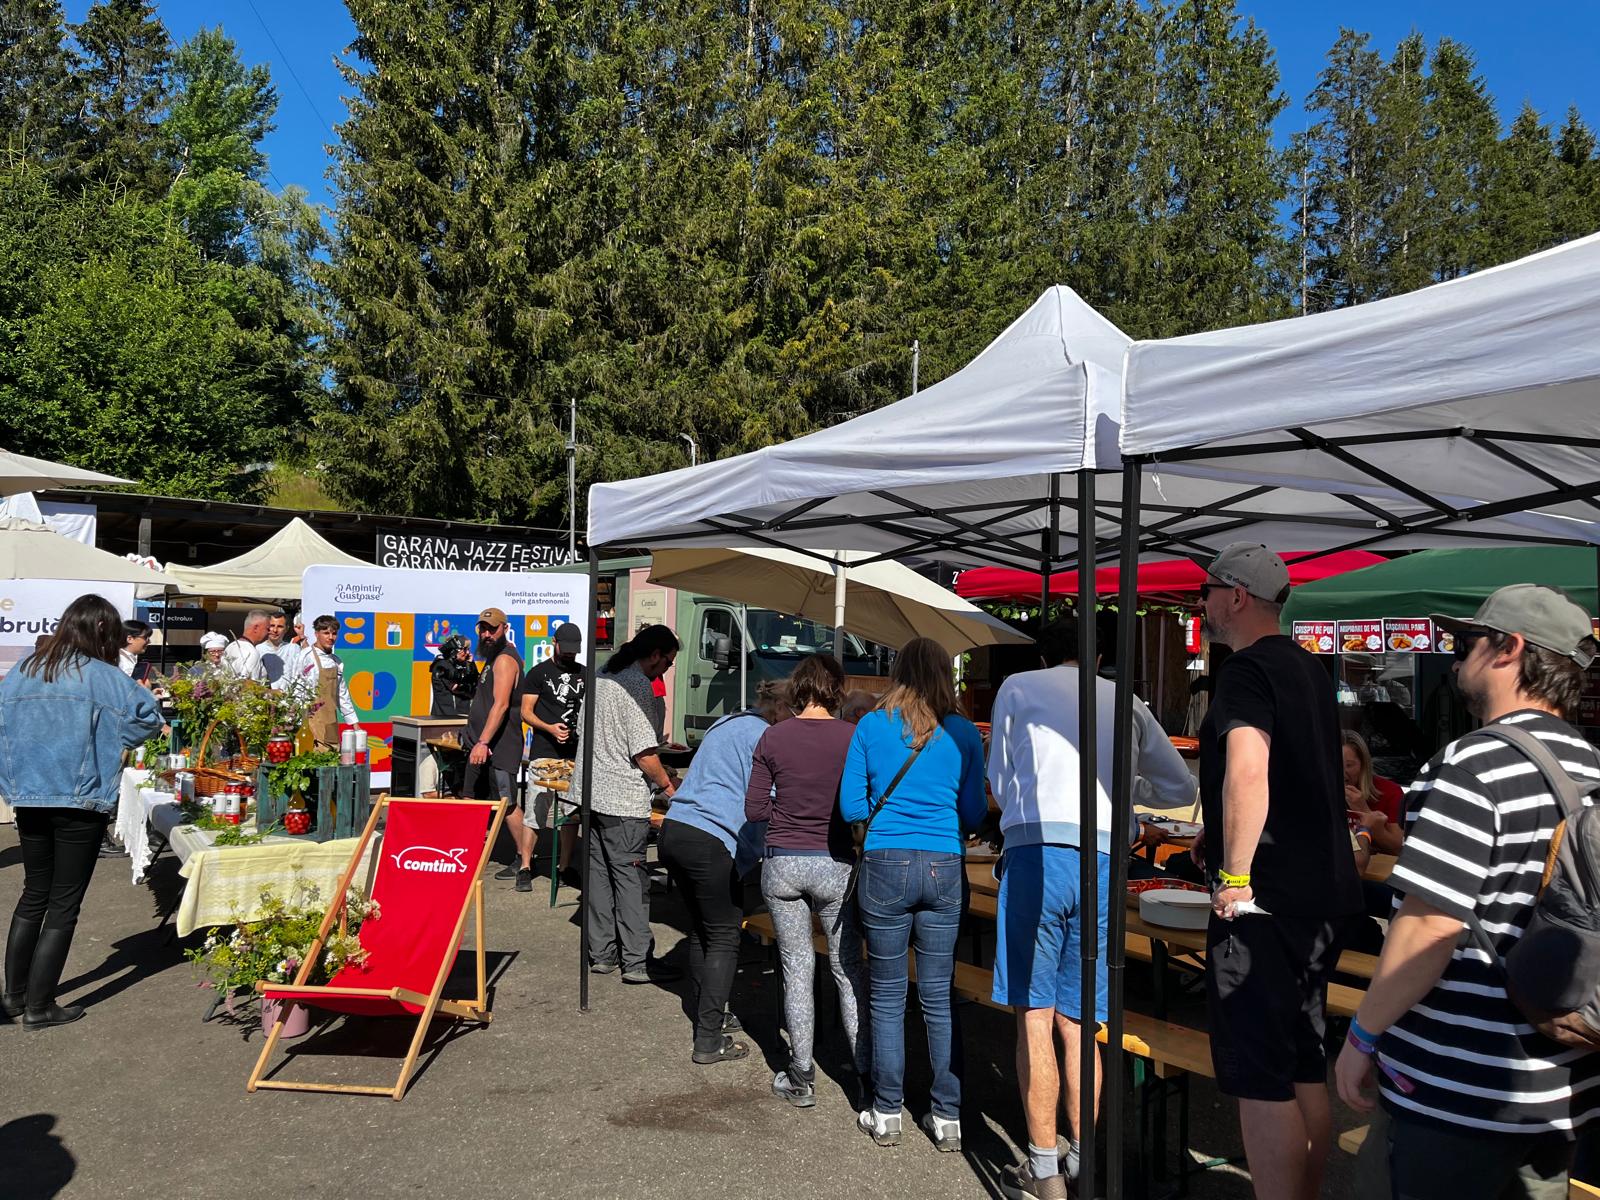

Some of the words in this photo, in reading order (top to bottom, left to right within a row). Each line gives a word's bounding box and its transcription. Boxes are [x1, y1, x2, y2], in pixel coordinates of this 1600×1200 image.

[383, 534, 460, 559] GĂRÂNA
[463, 541, 508, 561] JAZZ
[504, 590, 538, 598] Identitate
[527, 598, 570, 606] gastronomie
[1294, 625, 1314, 634] CRISPY
[1315, 625, 1322, 634] DE
[1323, 625, 1334, 634] PUI
[1363, 624, 1370, 632] DE
[1370, 624, 1380, 632] PUI
[1411, 623, 1426, 631] PANE
[403, 858, 457, 873] comtim
